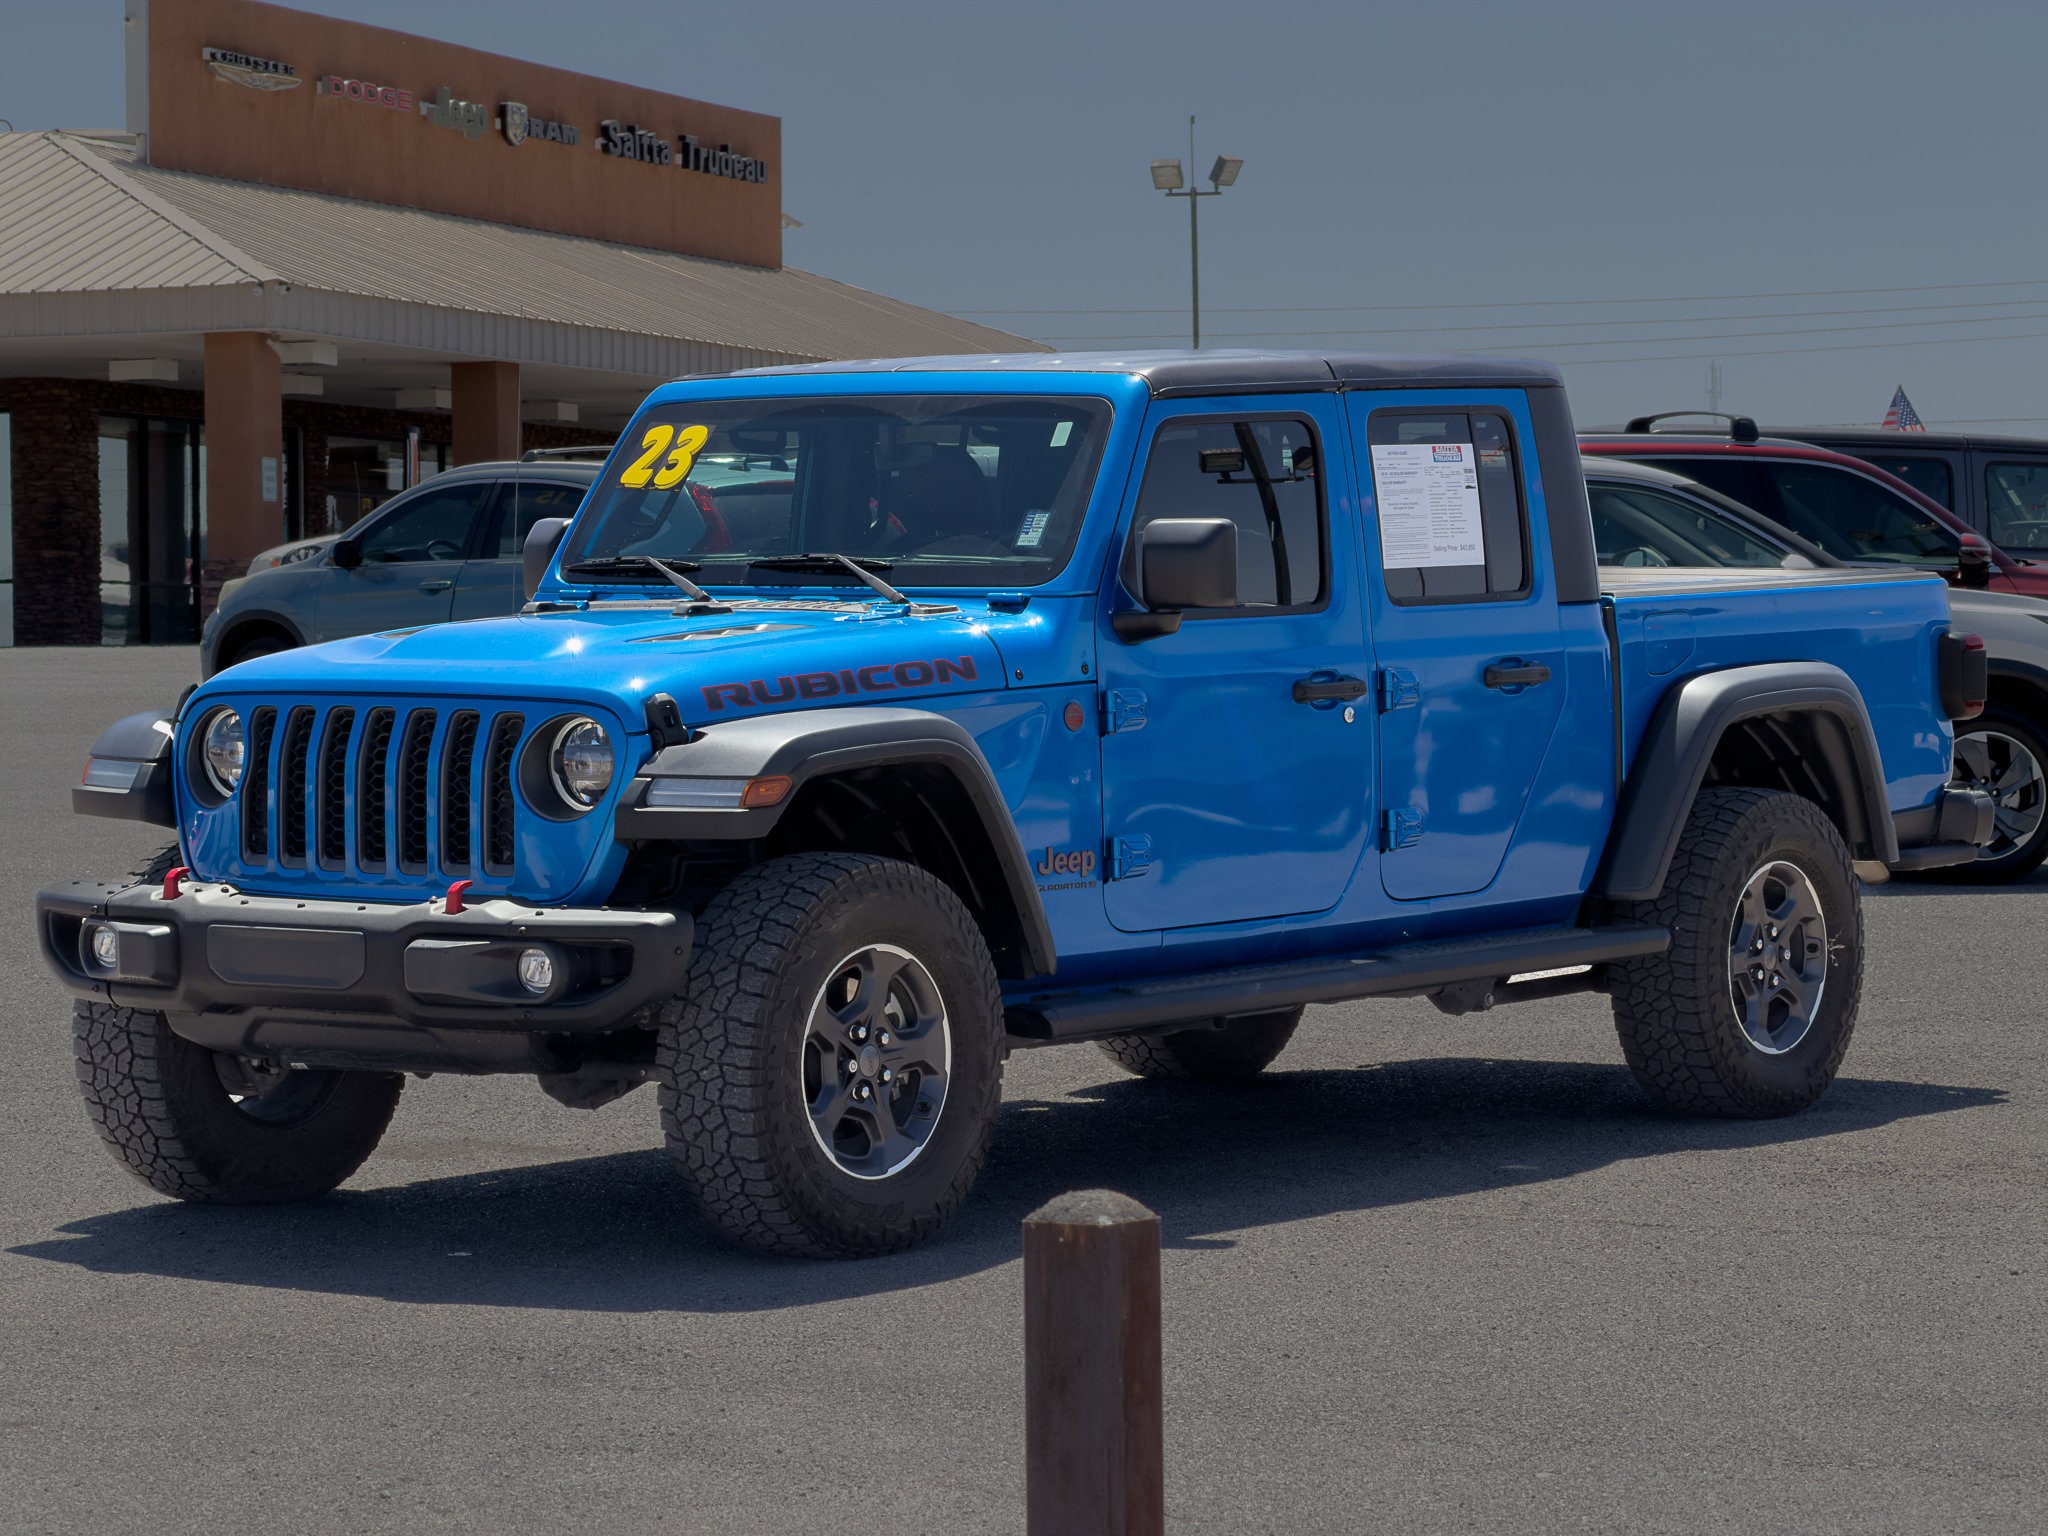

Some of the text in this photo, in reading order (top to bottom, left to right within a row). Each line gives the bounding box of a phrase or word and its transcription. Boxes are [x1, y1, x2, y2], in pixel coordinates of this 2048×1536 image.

[327, 75, 413, 112] DODGE
[426, 86, 488, 142] Jeep
[528, 117, 581, 146] RAM
[680, 133, 768, 184] Trudeau
[619, 424, 709, 490] 23
[701, 655, 978, 712] RUBICON
[1037, 845, 1096, 878] Jeep
